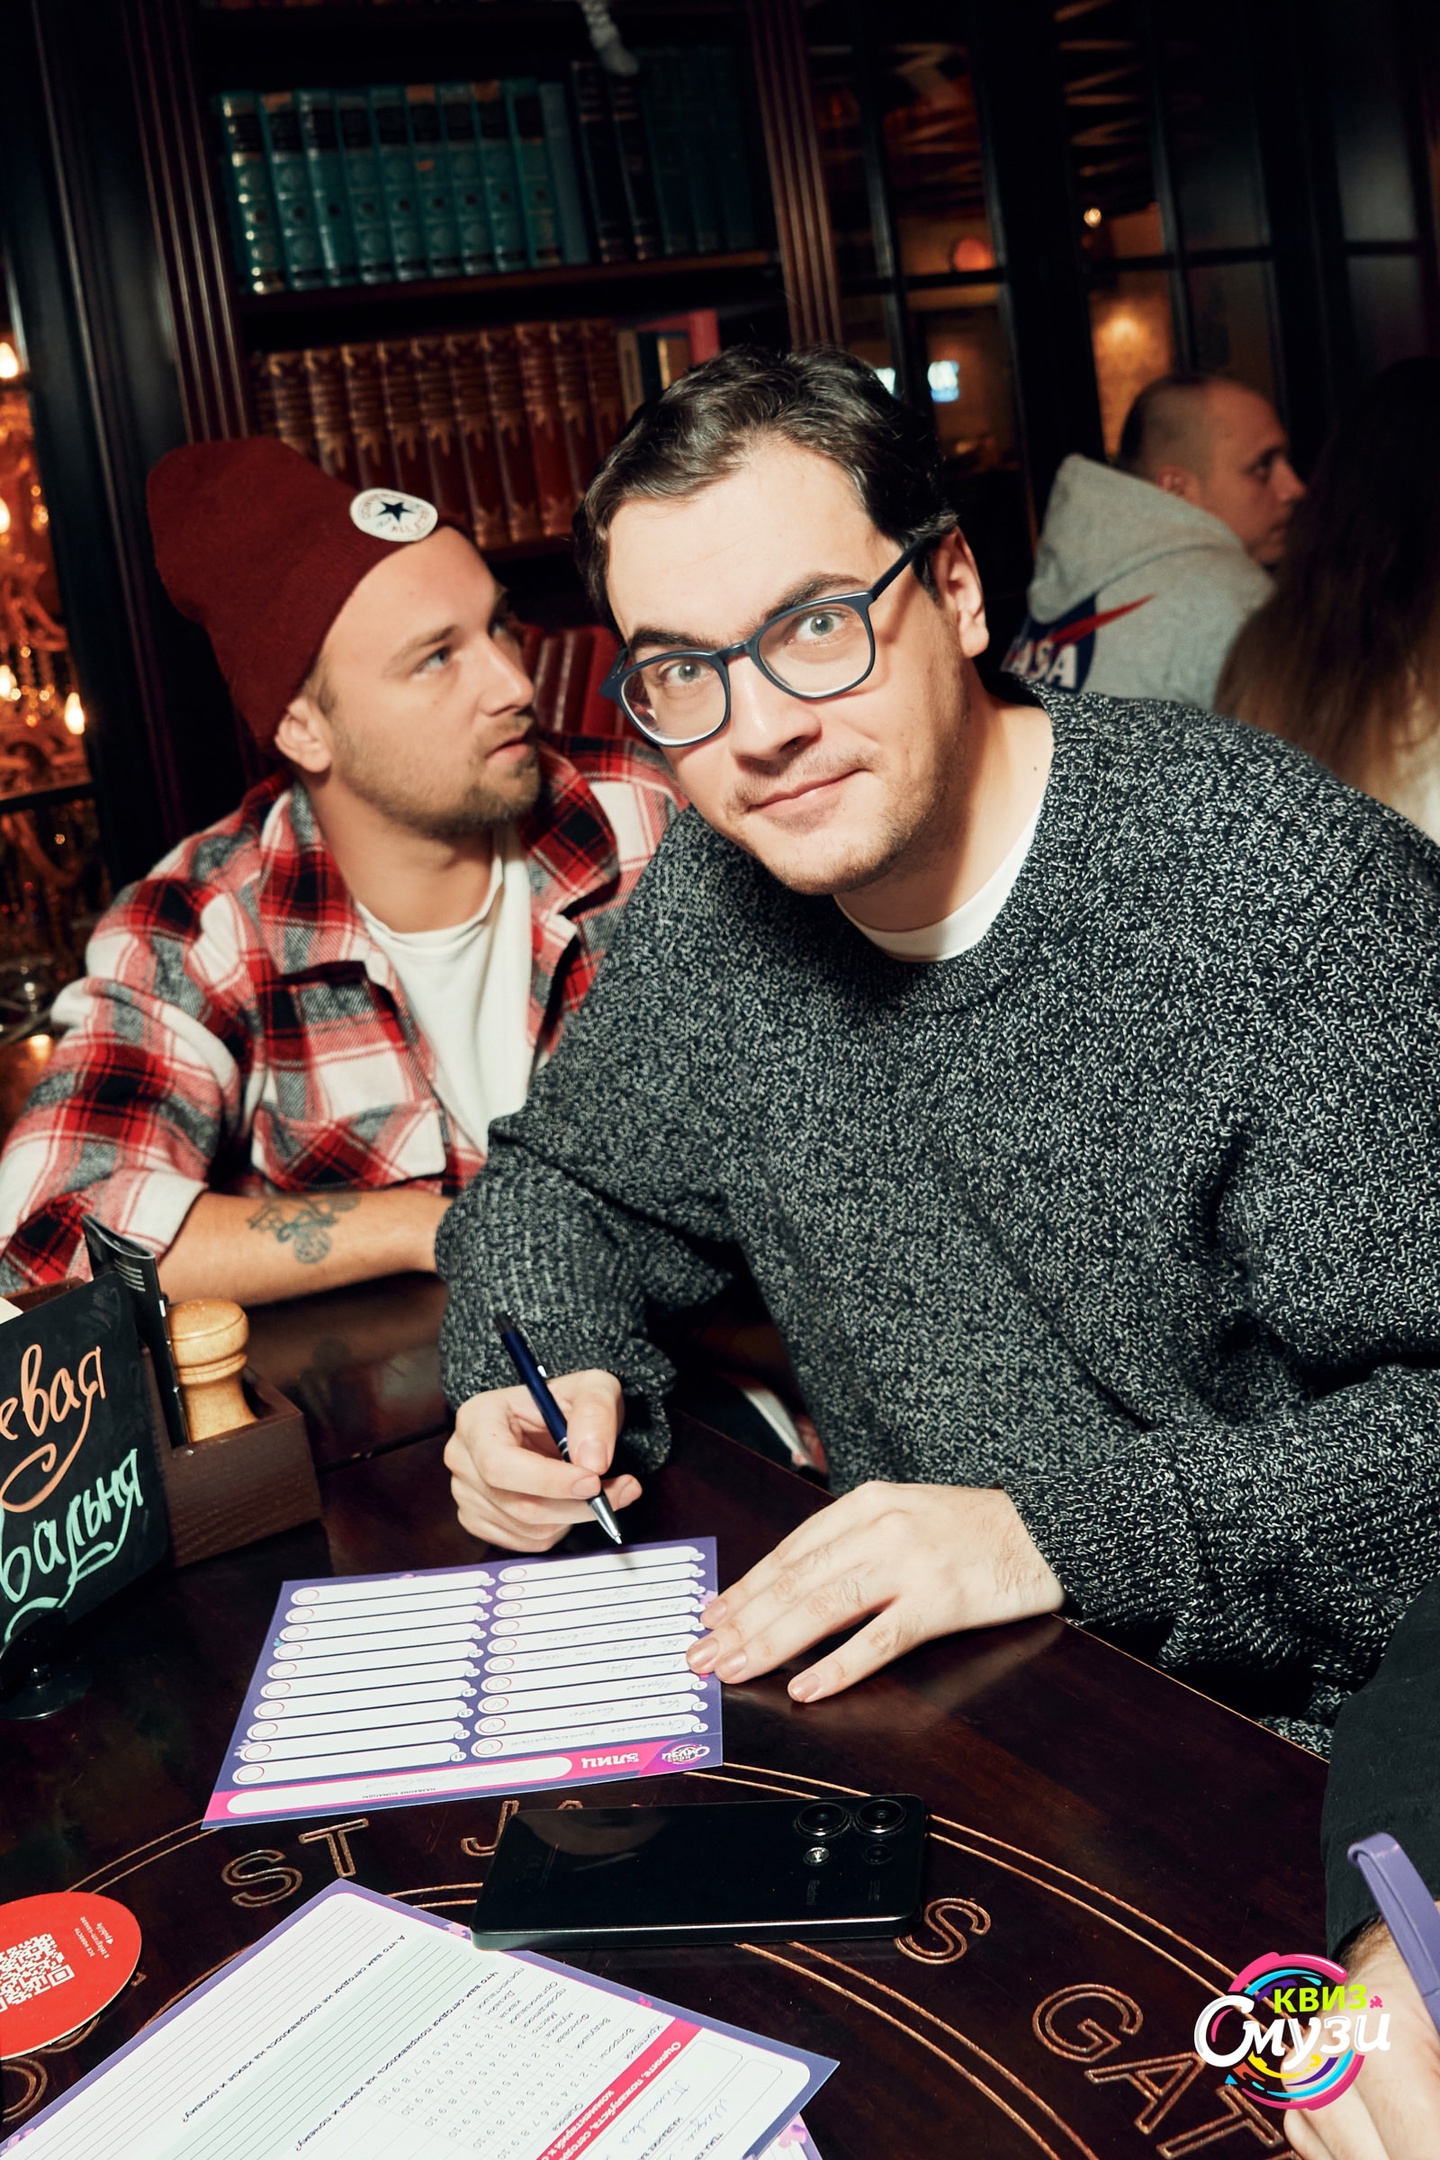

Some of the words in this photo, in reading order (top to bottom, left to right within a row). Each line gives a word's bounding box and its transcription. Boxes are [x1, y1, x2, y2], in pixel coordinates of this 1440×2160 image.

[580, 1750, 639, 1769] БЛИЦ
[367, 1954, 382, 1966] вам
[383, 1941, 398, 1952] что
[334, 1967, 366, 1993] сегодня
[466, 1985, 481, 1997] вам
[480, 1972, 498, 1983] Что
[322, 1994, 333, 2003] не
[510, 1982, 557, 2024] Организация
[433, 1999, 464, 2026] сегодня
[532, 2012, 557, 2033] Место
[266, 2004, 321, 2049] понравилось
[557, 2014, 589, 2043] Фоновая
[254, 2050, 266, 2059] на
[377, 2028, 432, 2074] понравилось
[626, 2025, 660, 2059] Критерий
[228, 2061, 252, 2081] квизе
[638, 2040, 684, 2080] Оцените,
[1032, 1983, 1304, 2160] GAT
[365, 2076, 377, 2085] на
[183, 2090, 219, 2122] почему?
[340, 2087, 365, 2108] квизе
[586, 2077, 647, 2133] пожалуйста,
[550, 2088, 617, 2150] комментарий
[552, 2104, 583, 2131] Оценка
[296, 2117, 331, 2151] почему?
